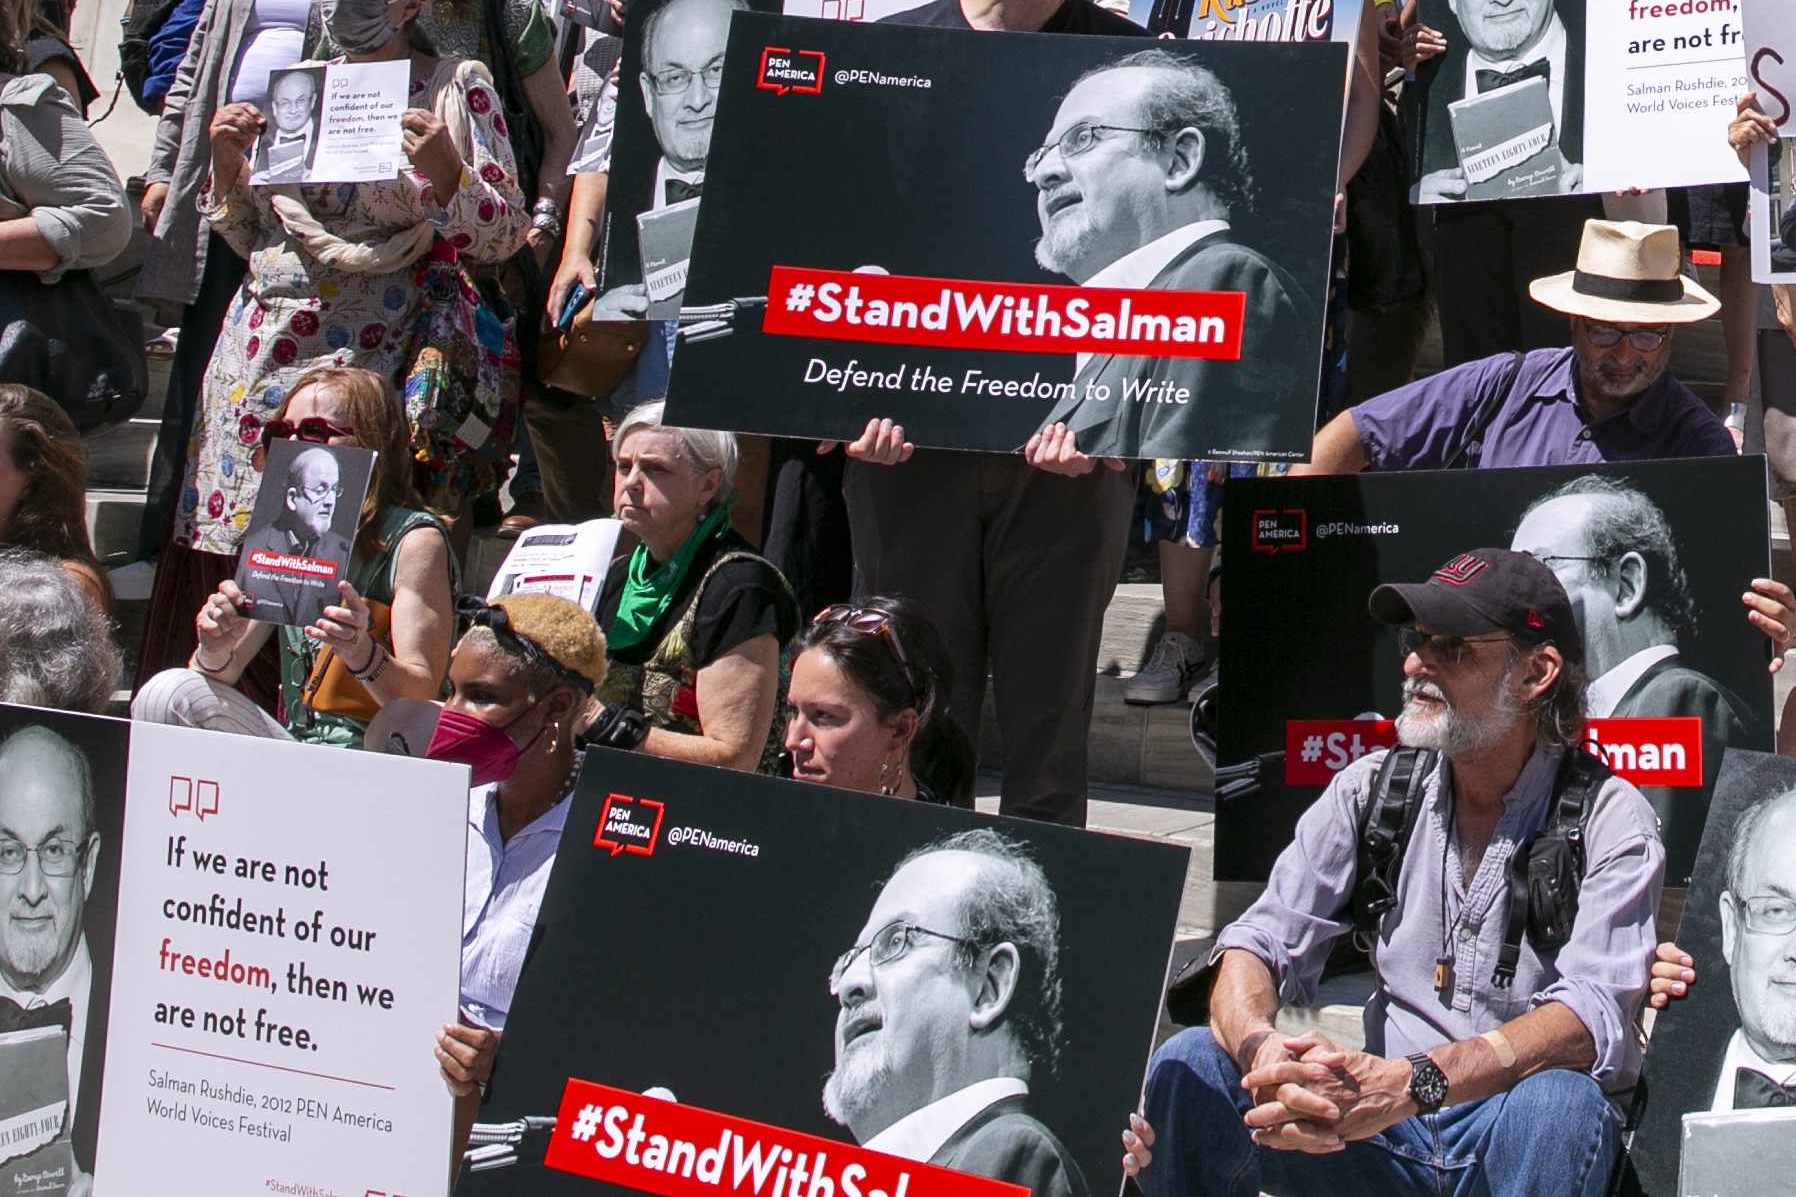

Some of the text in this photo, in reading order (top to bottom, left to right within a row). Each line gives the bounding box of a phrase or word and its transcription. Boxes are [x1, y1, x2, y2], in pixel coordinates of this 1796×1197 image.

[1261, 0, 1283, 12] NOVEL
[1628, 38, 1666, 53] are
[1674, 28, 1712, 49] not
[769, 58, 790, 68] PEN
[766, 68, 815, 81] AMERICA
[835, 70, 932, 88] @PENamerica
[331, 92, 338, 100] If
[330, 103, 368, 112] confident
[329, 115, 365, 124] freedom,
[358, 125, 376, 133] free.
[786, 281, 1226, 344] #StandWithSalman
[804, 358, 1191, 406] Defend the Freedom to Write
[1259, 520, 1277, 529] PEN
[1316, 522, 1399, 538] @PENamerica
[1259, 529, 1299, 539] AMERICA
[252, 553, 334, 574] #StandWithSalman
[609, 807, 631, 821] PEN
[605, 820, 650, 839] AMERICA
[668, 827, 759, 856] @PENamerica
[167, 836, 329, 891] If we are not
[162, 894, 377, 952] confident of our
[159, 938, 395, 1010] freedom, then we
[154, 1002, 319, 1052] are not free.
[148, 1069, 392, 1132] Salman Rushdie, 2012 PEN America
[147, 1097, 292, 1142] World Voices Festival
